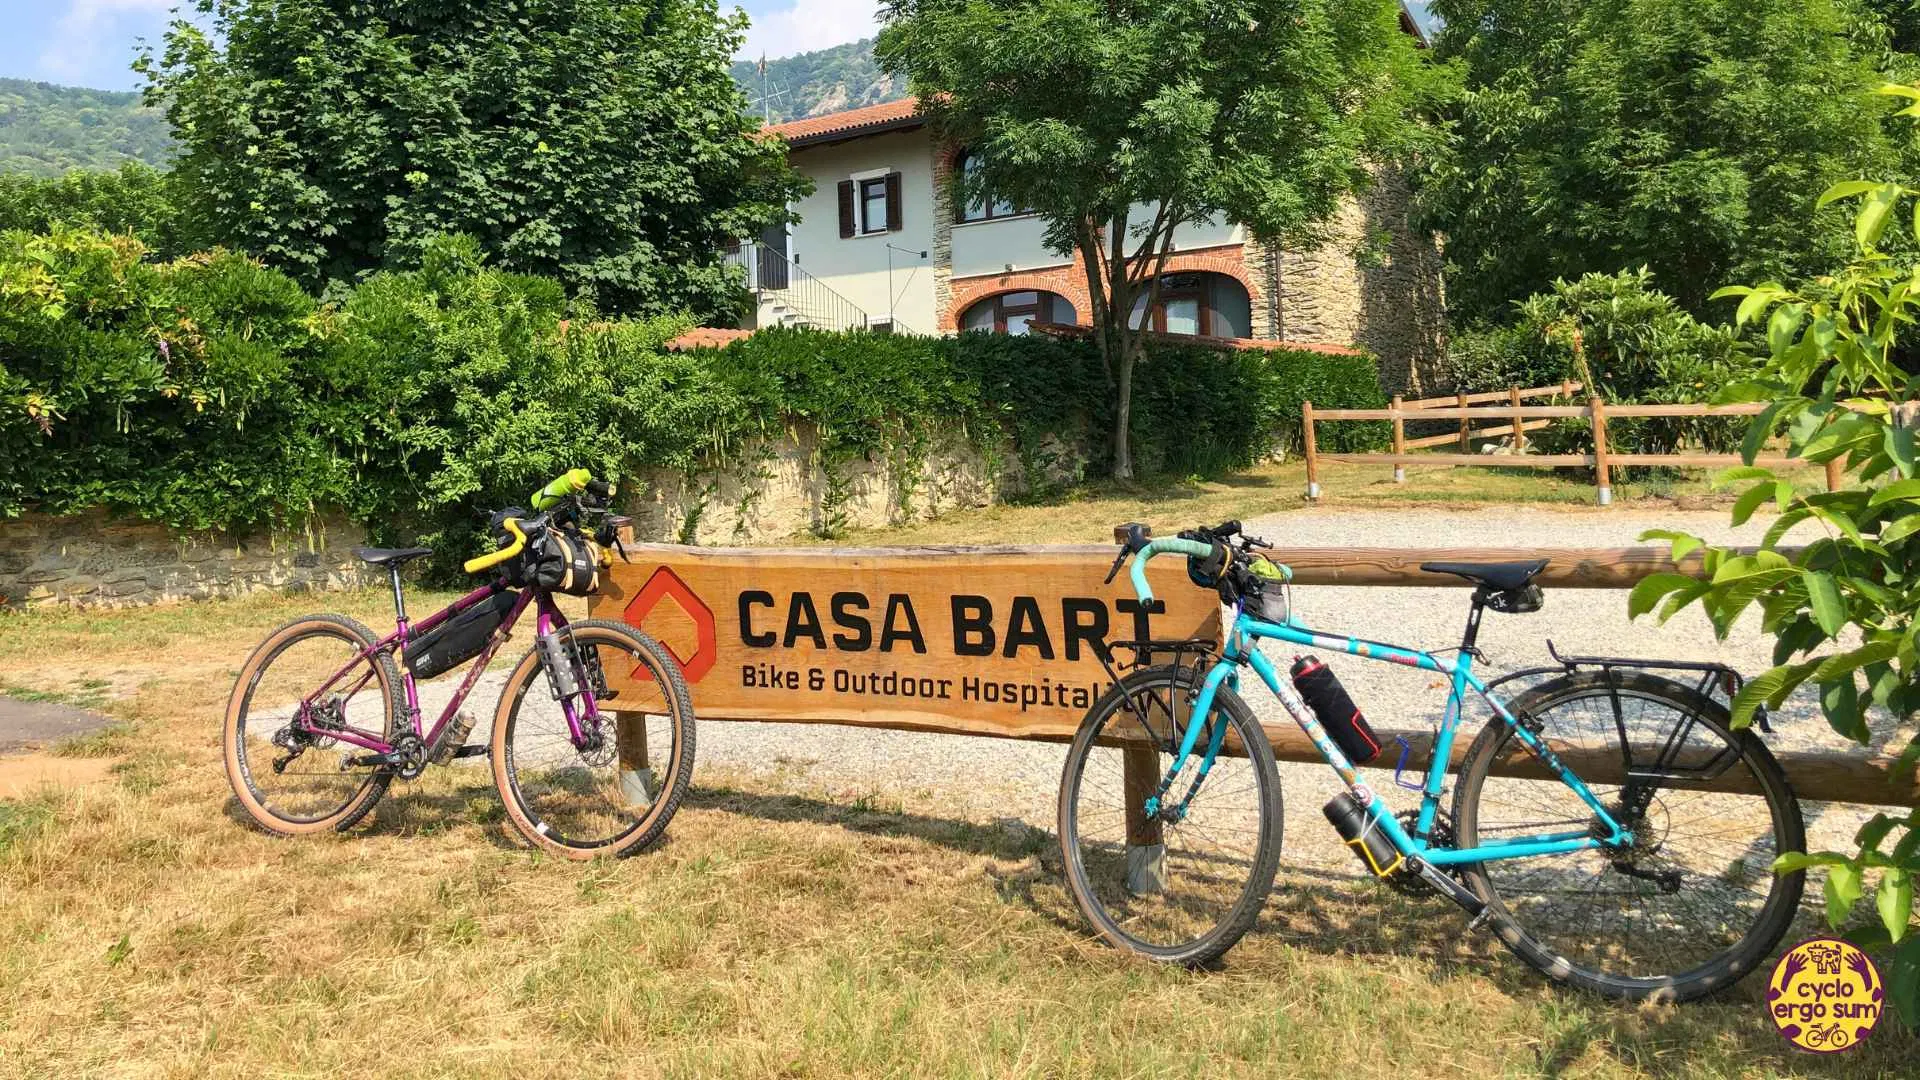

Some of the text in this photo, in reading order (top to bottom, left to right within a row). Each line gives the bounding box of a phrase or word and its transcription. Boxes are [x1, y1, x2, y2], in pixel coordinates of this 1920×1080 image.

[738, 590, 1166, 665] CASA BART
[742, 665, 800, 690] Bike
[807, 668, 826, 692] &
[833, 668, 953, 701] Outdoor
